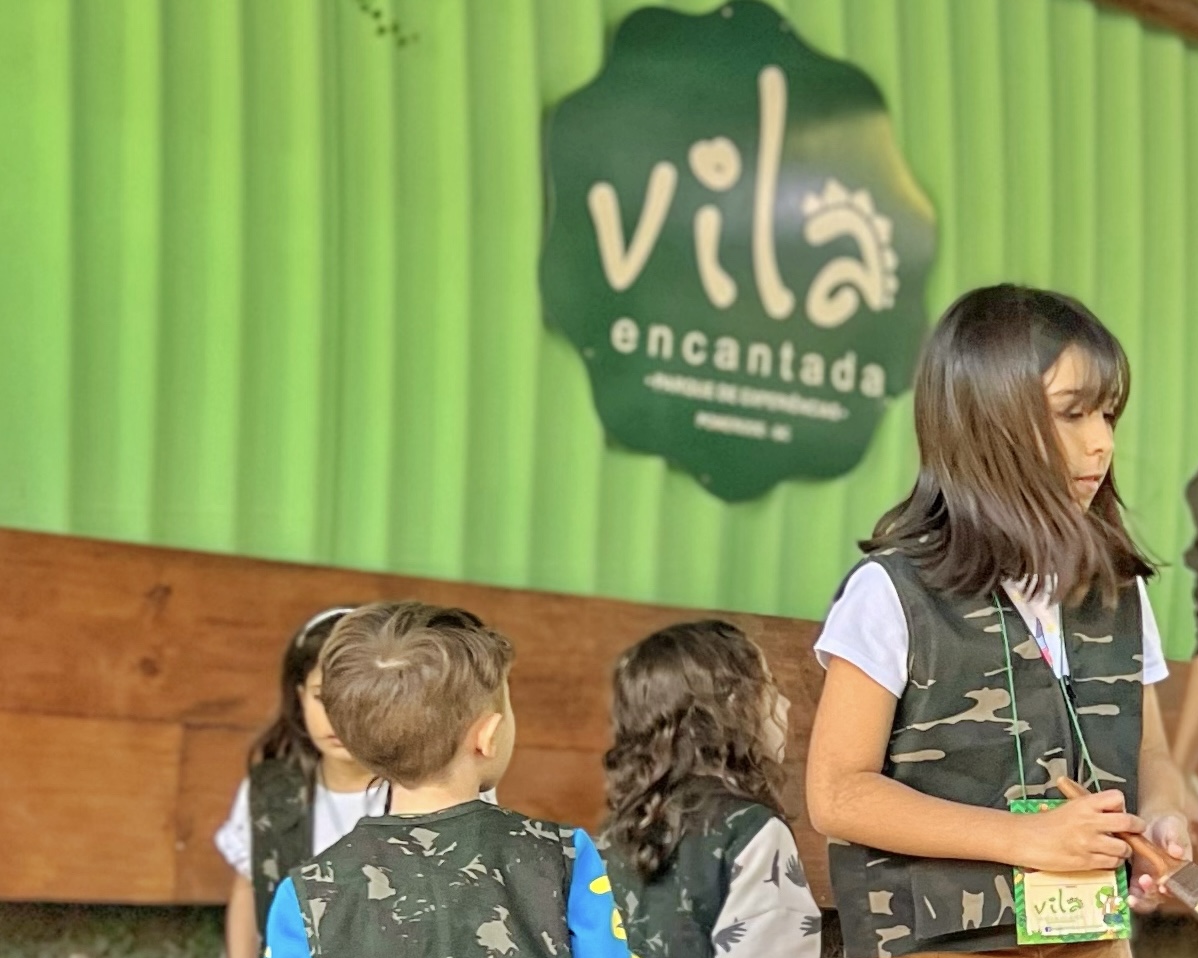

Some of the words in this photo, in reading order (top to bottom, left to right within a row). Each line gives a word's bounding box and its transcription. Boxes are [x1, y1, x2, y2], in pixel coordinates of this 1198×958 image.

[587, 64, 899, 328] vila
[609, 316, 886, 398] encantada
[1034, 888, 1083, 914] vila
